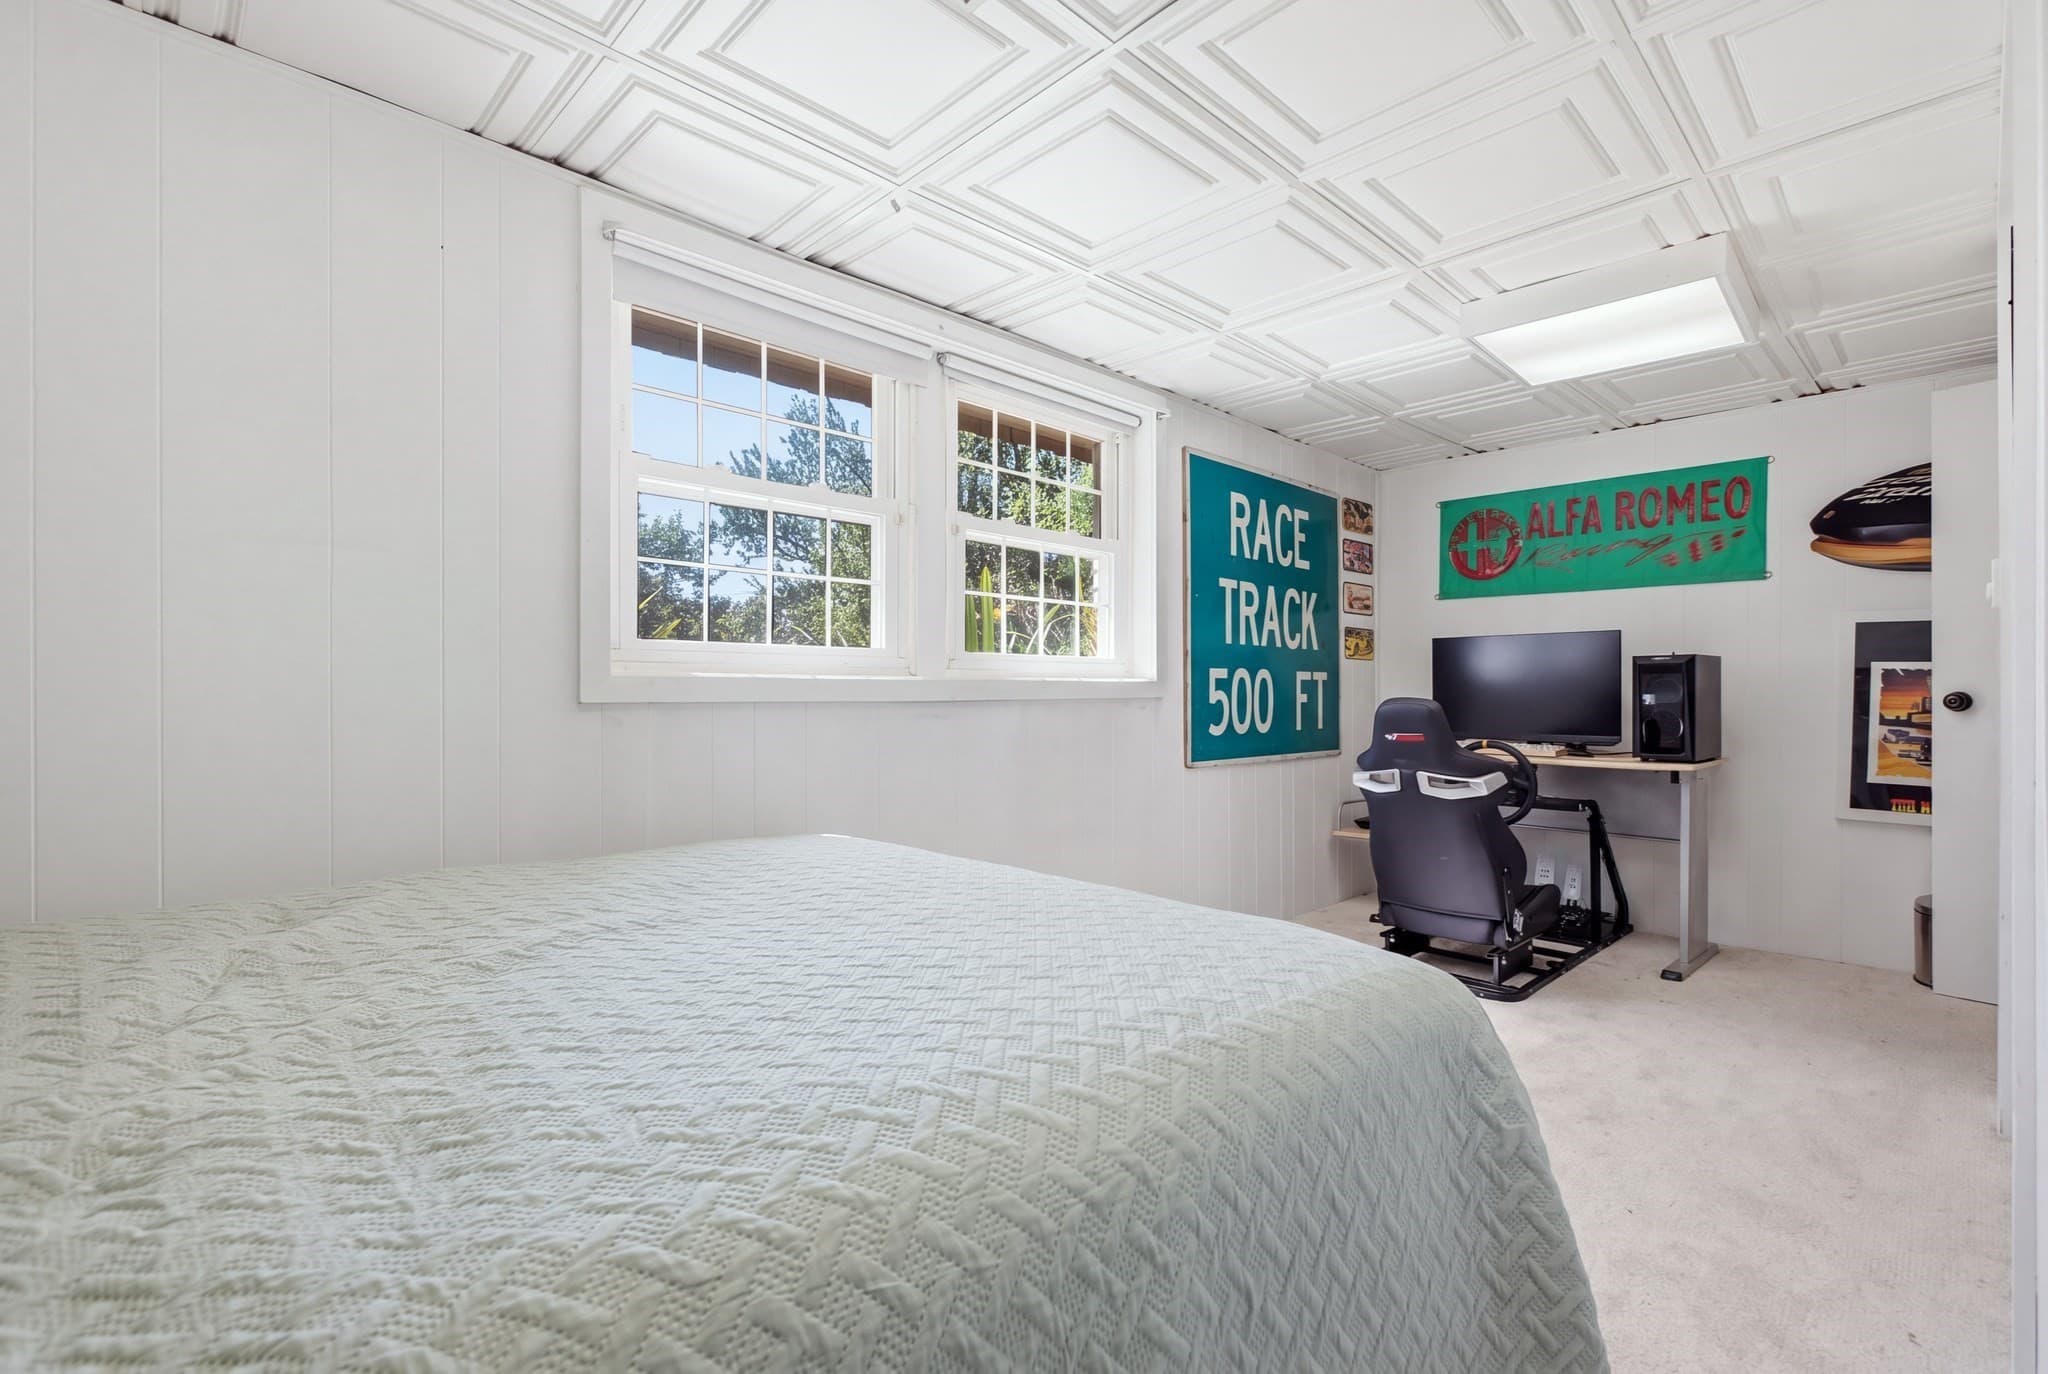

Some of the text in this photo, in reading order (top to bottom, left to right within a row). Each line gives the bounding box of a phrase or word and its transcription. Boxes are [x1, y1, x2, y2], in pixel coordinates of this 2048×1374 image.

[1230, 491, 1310, 570] RACE
[1527, 495, 1602, 539] ALFA
[1616, 475, 1751, 531] ROMEO
[1218, 577, 1319, 650] TRACK
[1208, 667, 1328, 737] 500 FT
